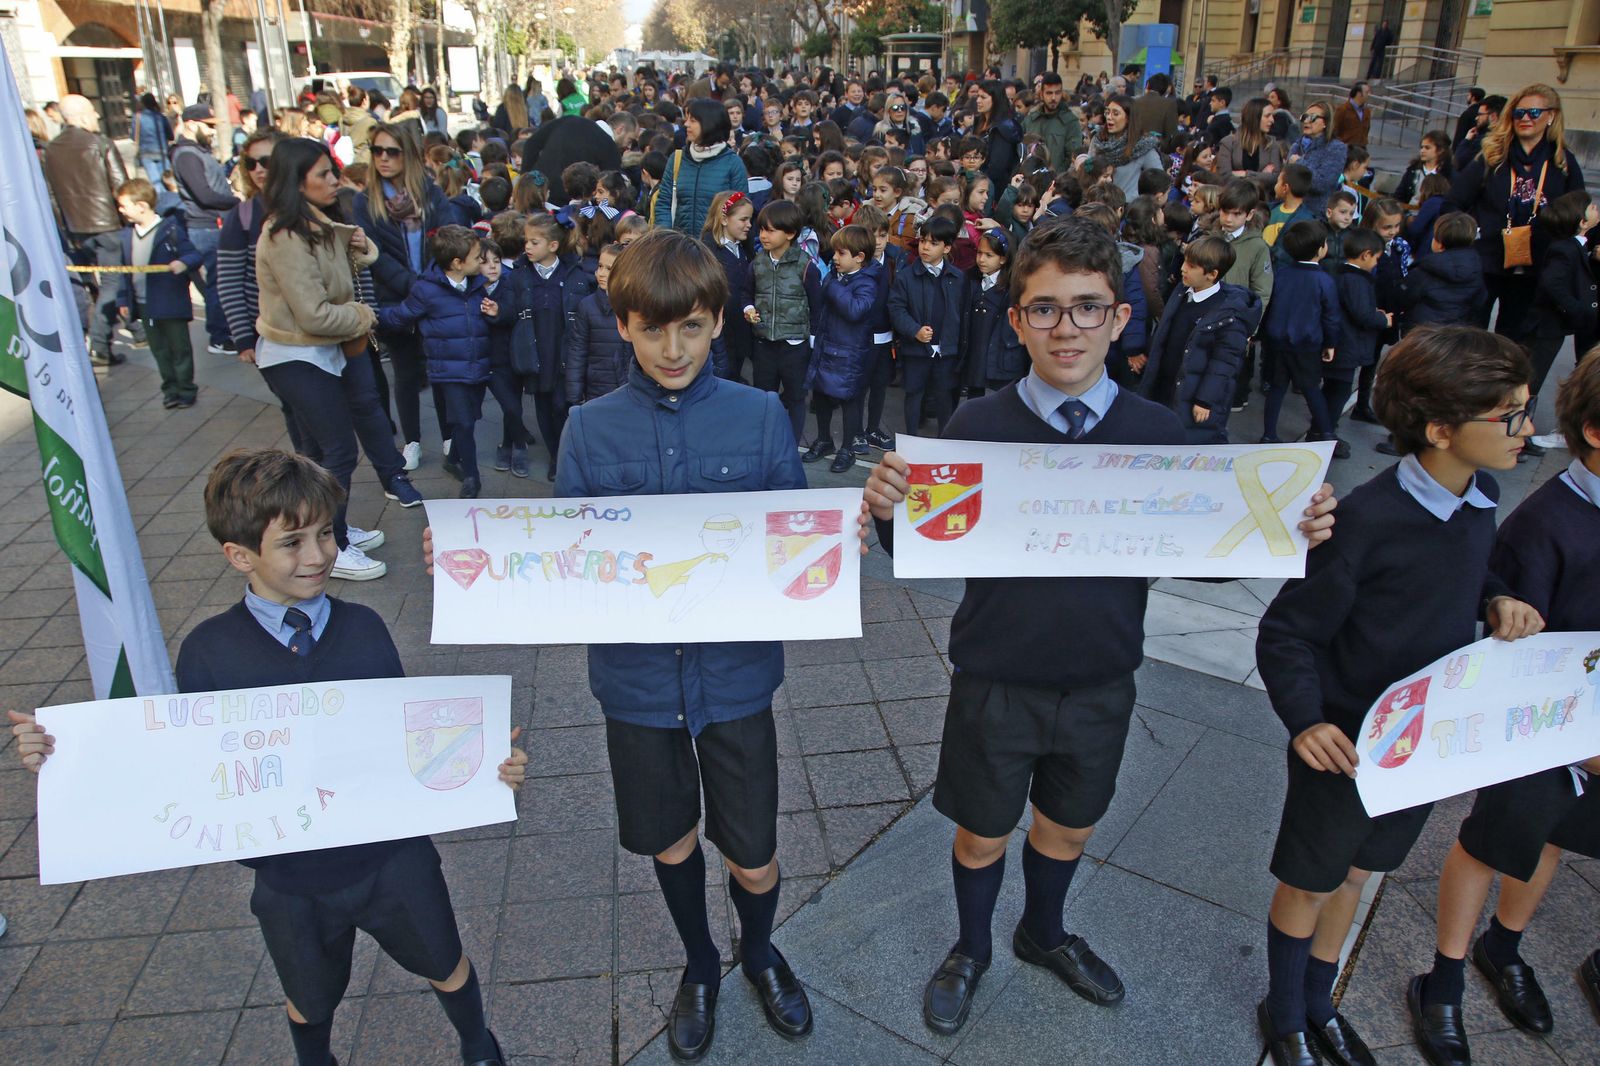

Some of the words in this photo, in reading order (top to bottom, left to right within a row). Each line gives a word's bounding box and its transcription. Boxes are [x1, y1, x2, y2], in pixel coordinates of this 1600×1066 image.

[465, 502, 632, 543] pequeños
[1018, 499, 1100, 516] CONTRA
[1104, 499, 1137, 516] EL
[143, 686, 345, 731] LUCHANDO
[1431, 712, 1485, 759] THE
[1505, 695, 1579, 742] POWER
[220, 727, 291, 753] CON
[153, 786, 336, 852] SONRISA
